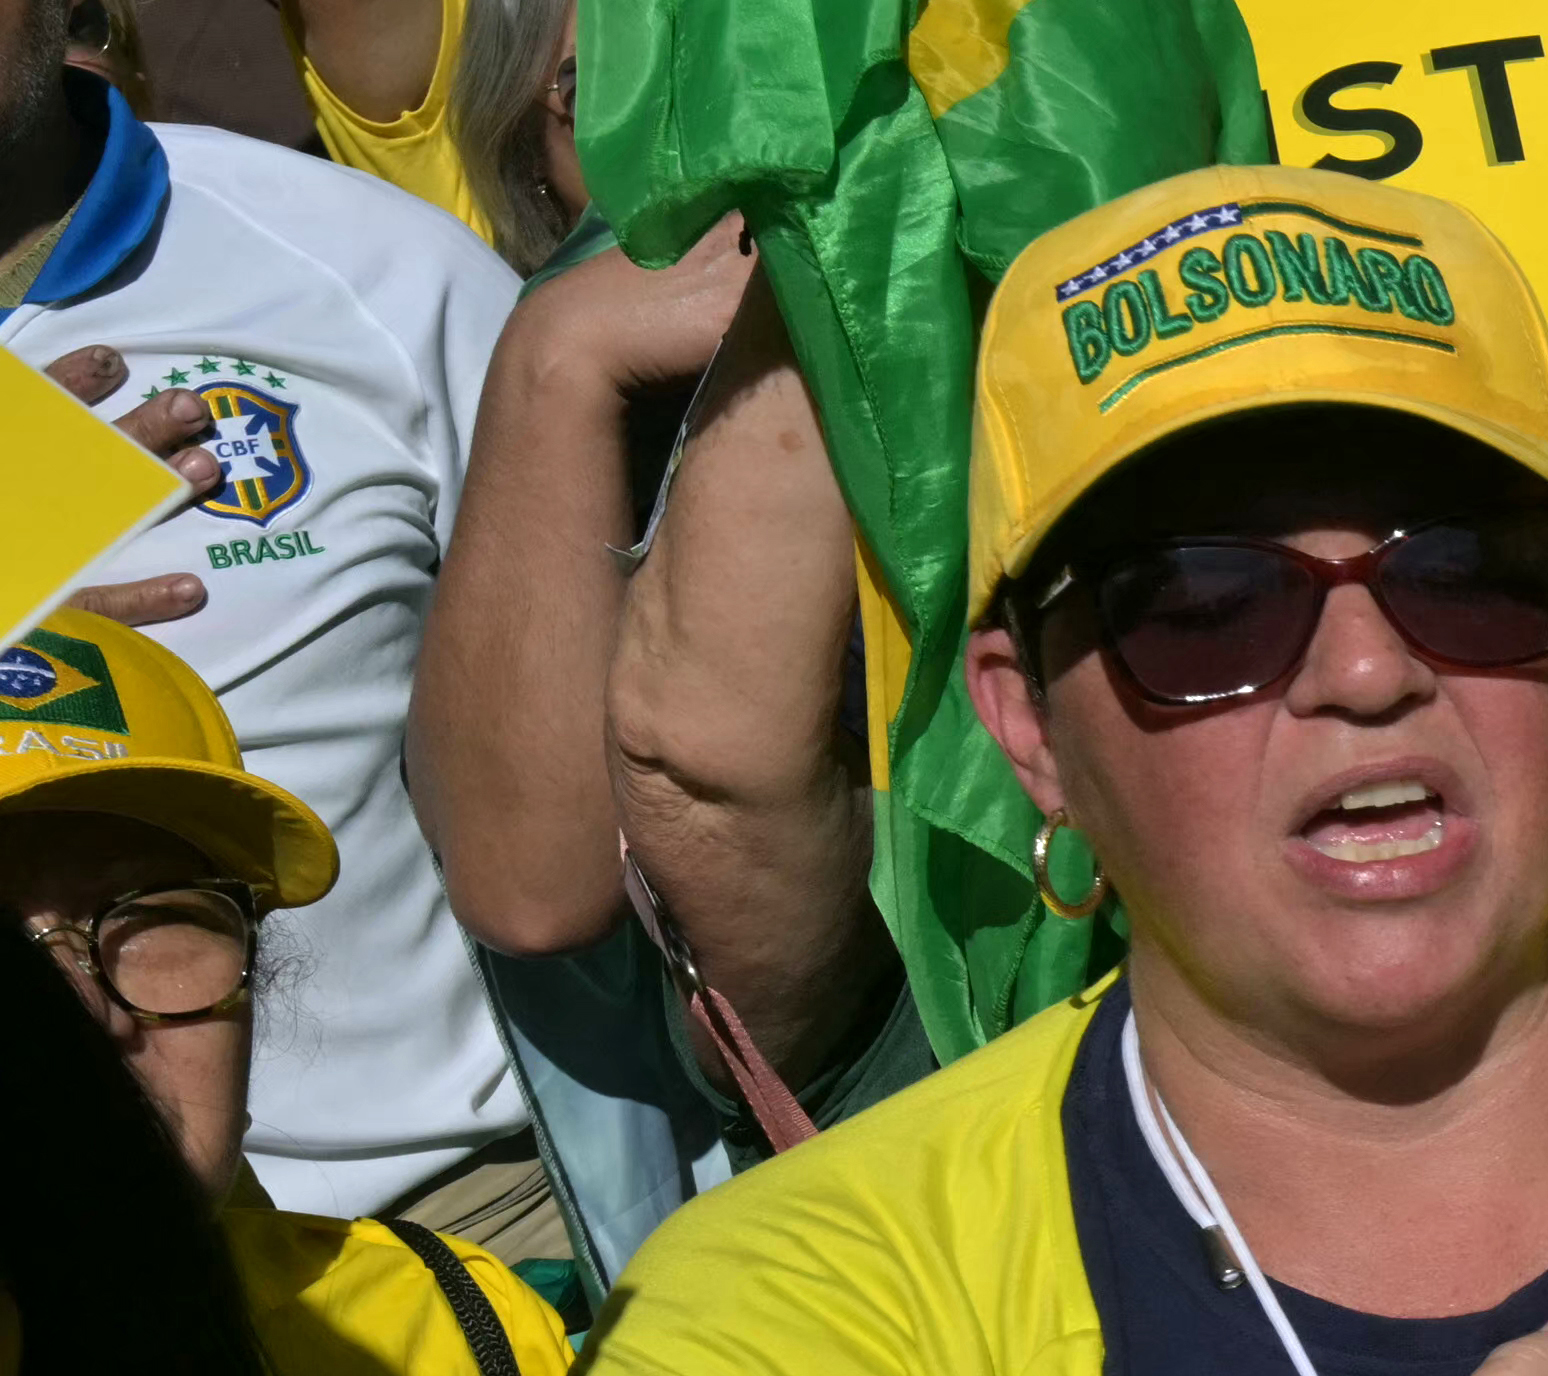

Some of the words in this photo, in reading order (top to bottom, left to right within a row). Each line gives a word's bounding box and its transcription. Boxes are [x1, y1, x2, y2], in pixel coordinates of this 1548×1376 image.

[1059, 229, 1457, 387] BOLSONARO
[214, 433, 262, 463] CBF
[203, 527, 327, 572] BRASIL
